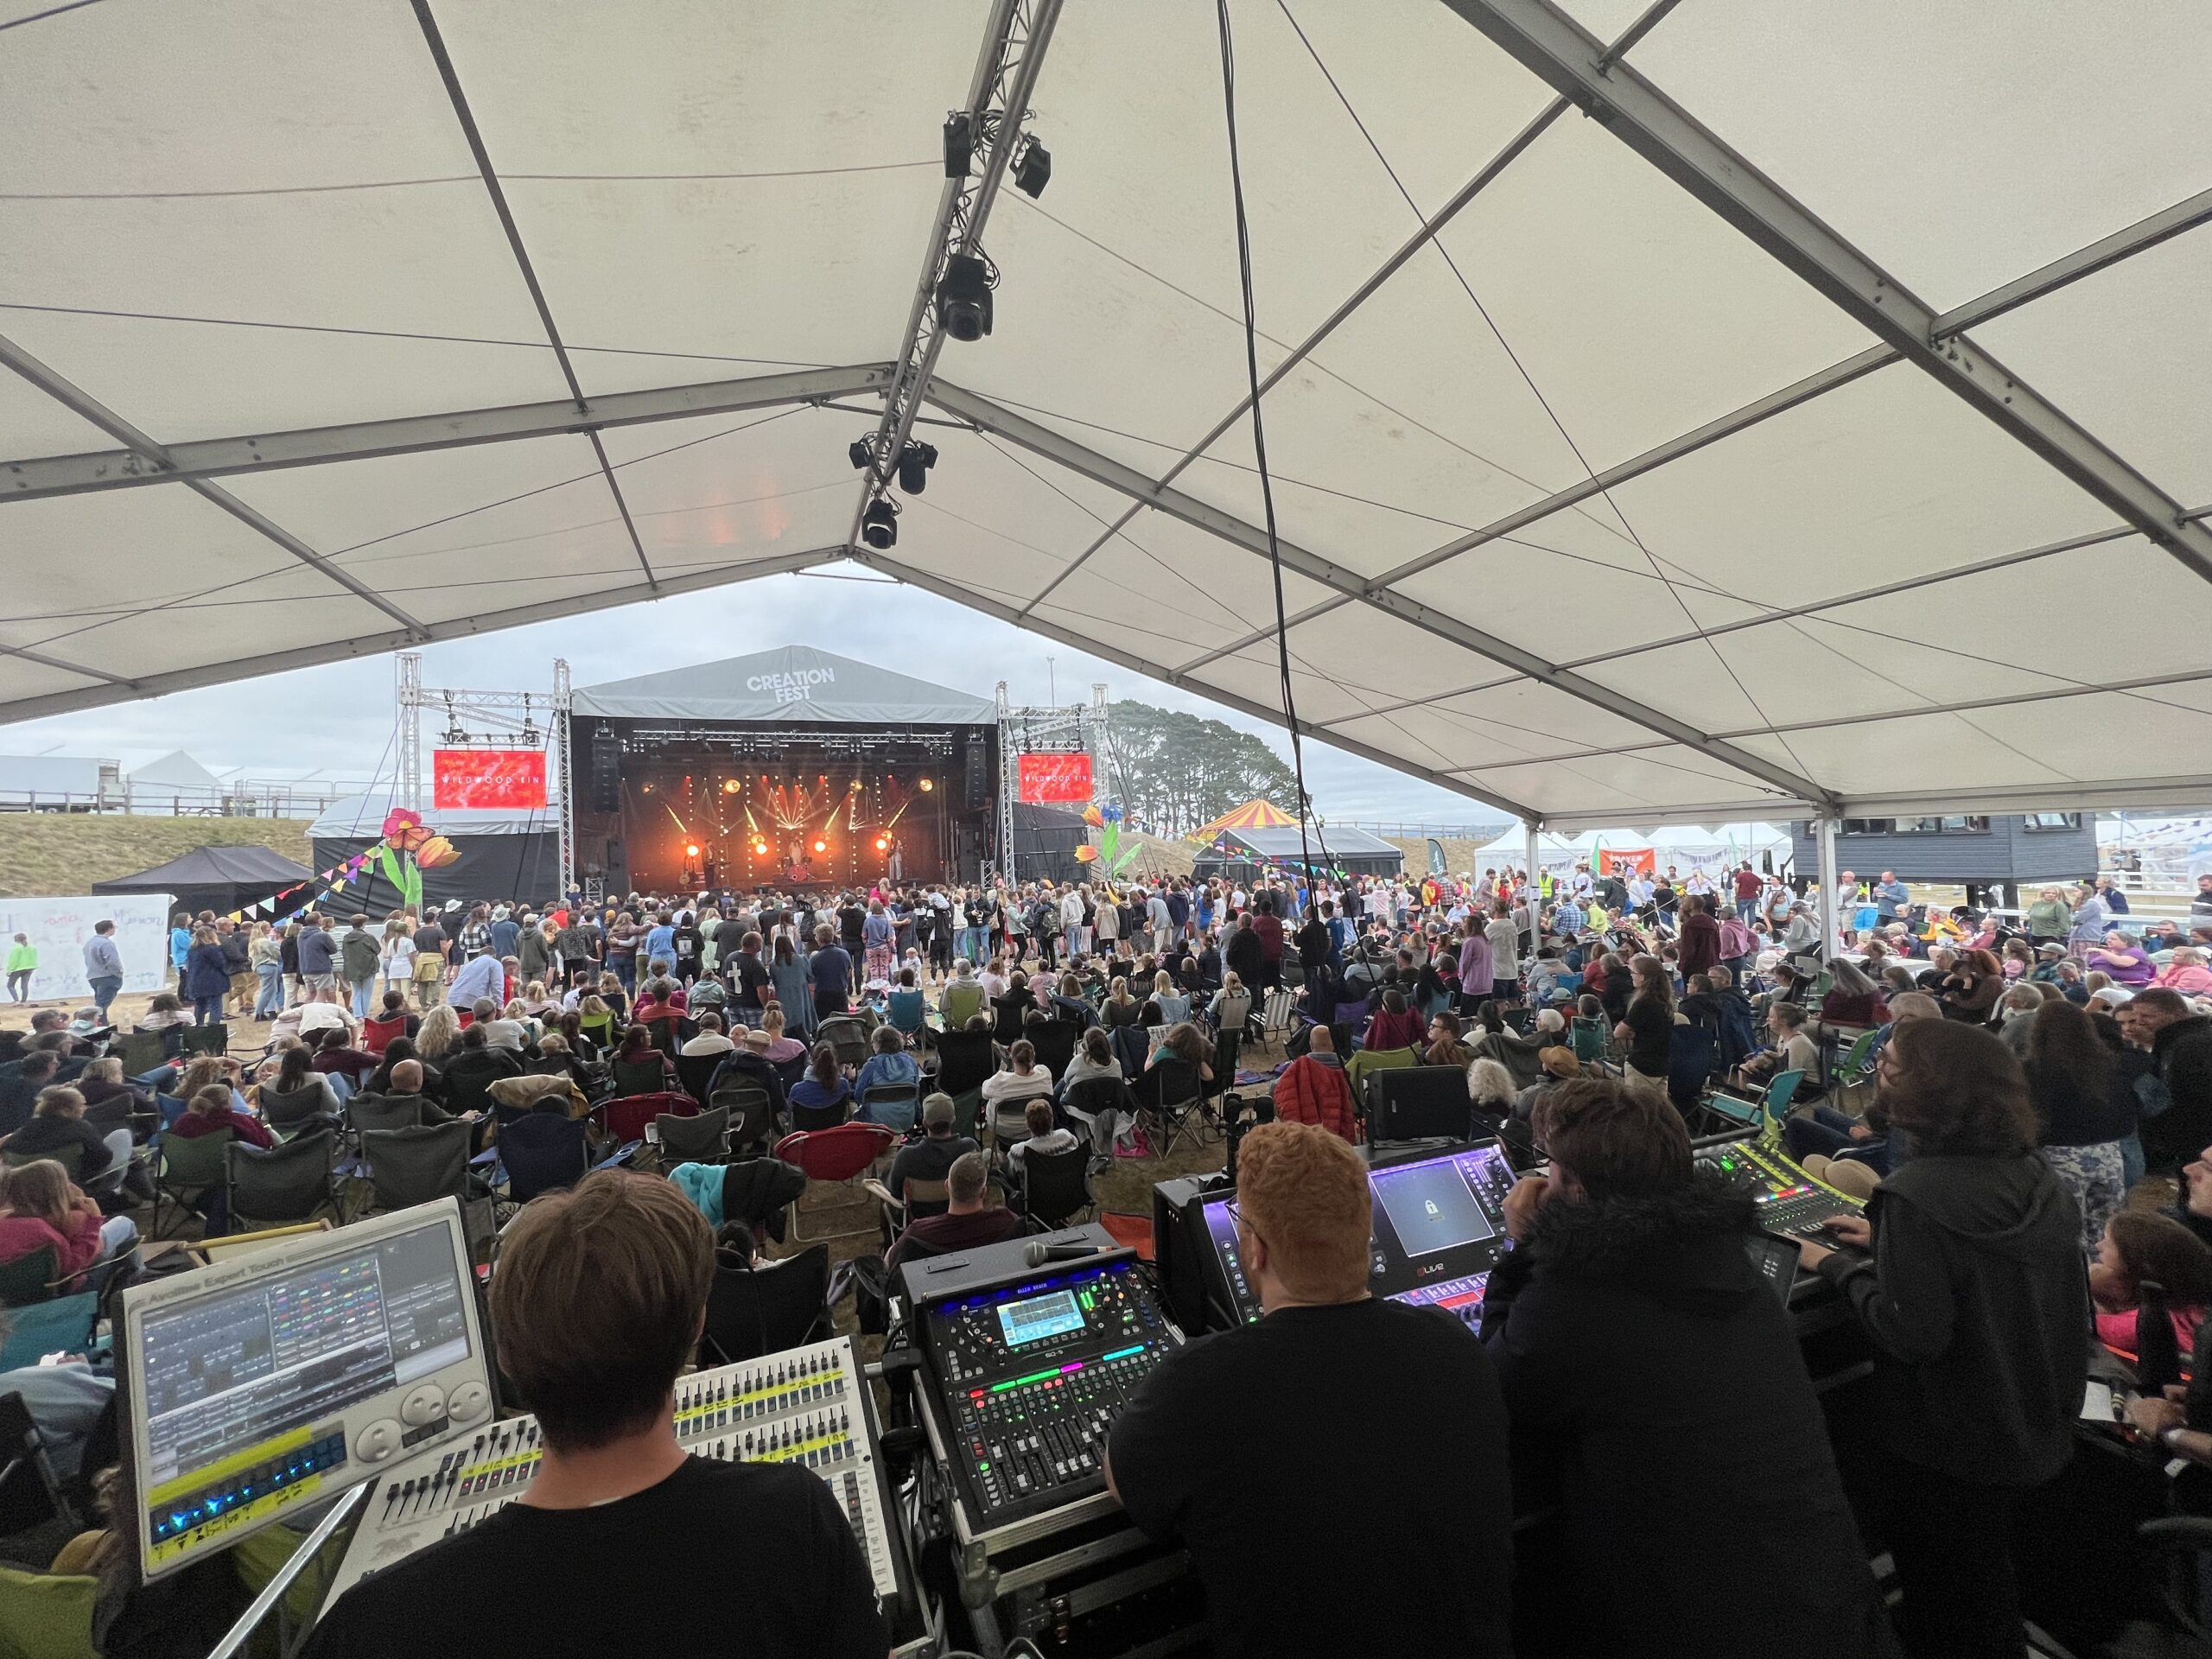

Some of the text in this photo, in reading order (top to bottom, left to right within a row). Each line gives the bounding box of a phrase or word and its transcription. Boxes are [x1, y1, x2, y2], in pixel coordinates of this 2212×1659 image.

[747, 668, 835, 691] CREATION
[775, 685, 810, 702] FEST
[205, 1268, 246, 1288] Expert
[249, 1258, 284, 1274] Touch
